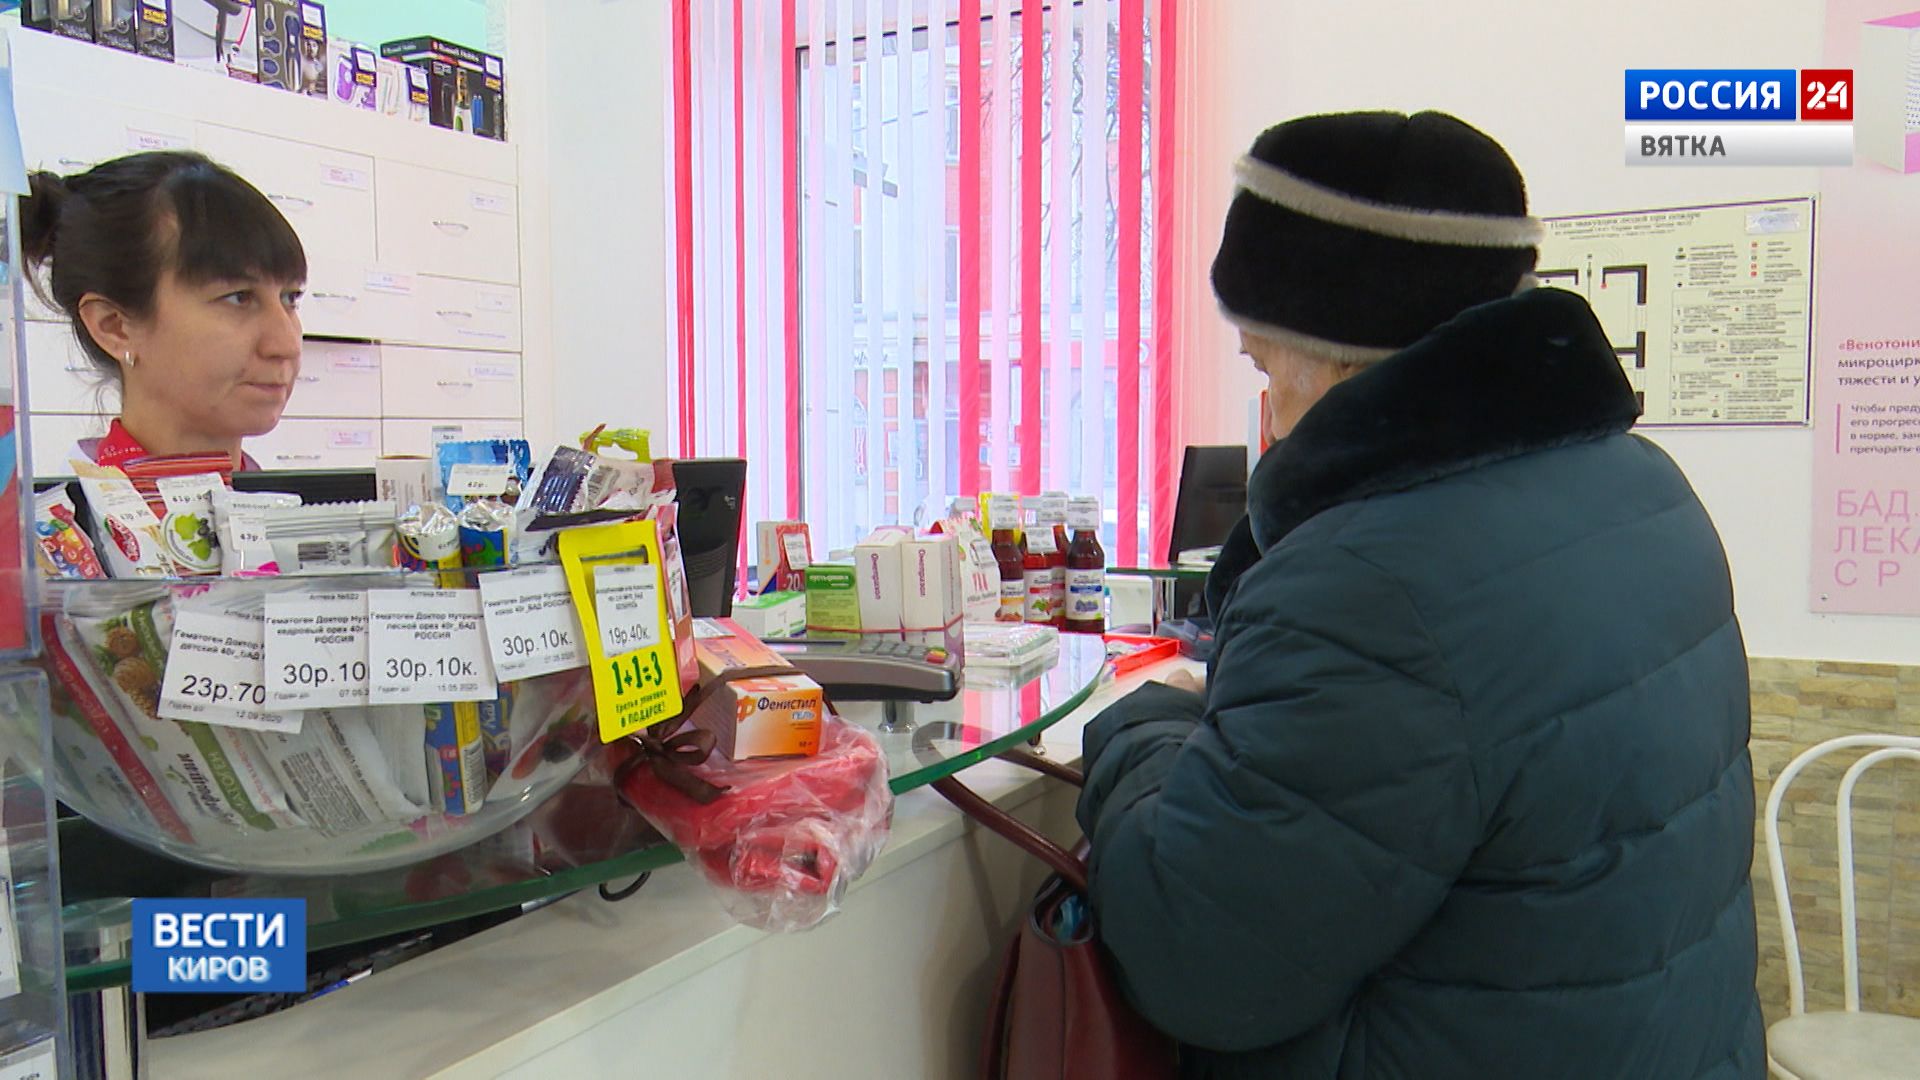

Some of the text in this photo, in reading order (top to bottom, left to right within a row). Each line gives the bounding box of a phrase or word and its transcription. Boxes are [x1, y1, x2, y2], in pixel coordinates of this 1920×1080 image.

[1838, 376, 1897, 386] тяжести
[1900, 376, 1909, 384] и
[1851, 404, 1886, 413] Чтобы
[1850, 419, 1869, 427] его
[502, 629, 573, 656] 30р.10к.
[283, 661, 370, 687] 30р.10
[386, 657, 477, 681] 30р.10к.
[612, 651, 663, 696] 1+1=3
[757, 696, 816, 711] Фенистил
